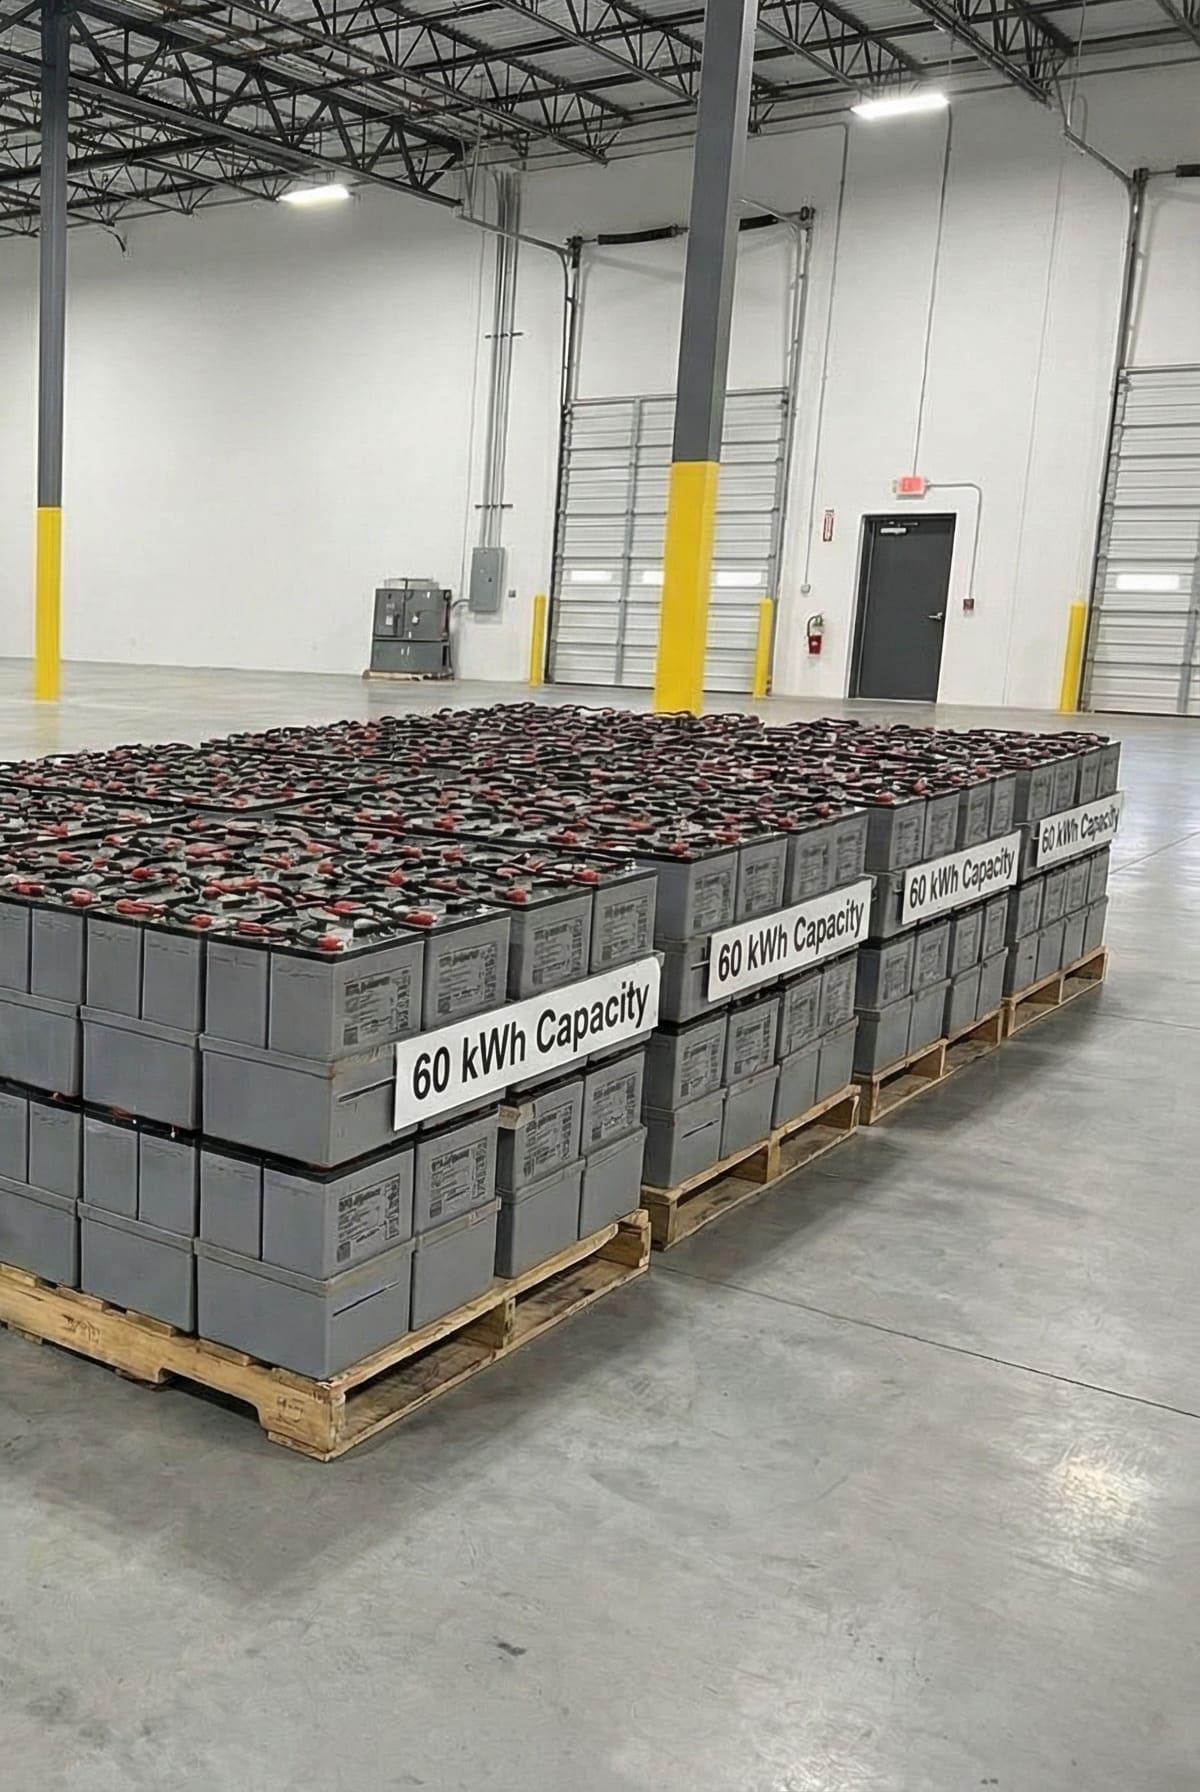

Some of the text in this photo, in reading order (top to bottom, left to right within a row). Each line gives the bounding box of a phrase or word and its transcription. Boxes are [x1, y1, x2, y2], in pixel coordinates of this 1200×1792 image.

[1042, 824, 1055, 854] 60
[910, 847, 1015, 909] 60 kWh Capacity
[718, 898, 865, 982] 60 kWh Capacity
[413, 980, 651, 1101] 60 kWh Capacity
